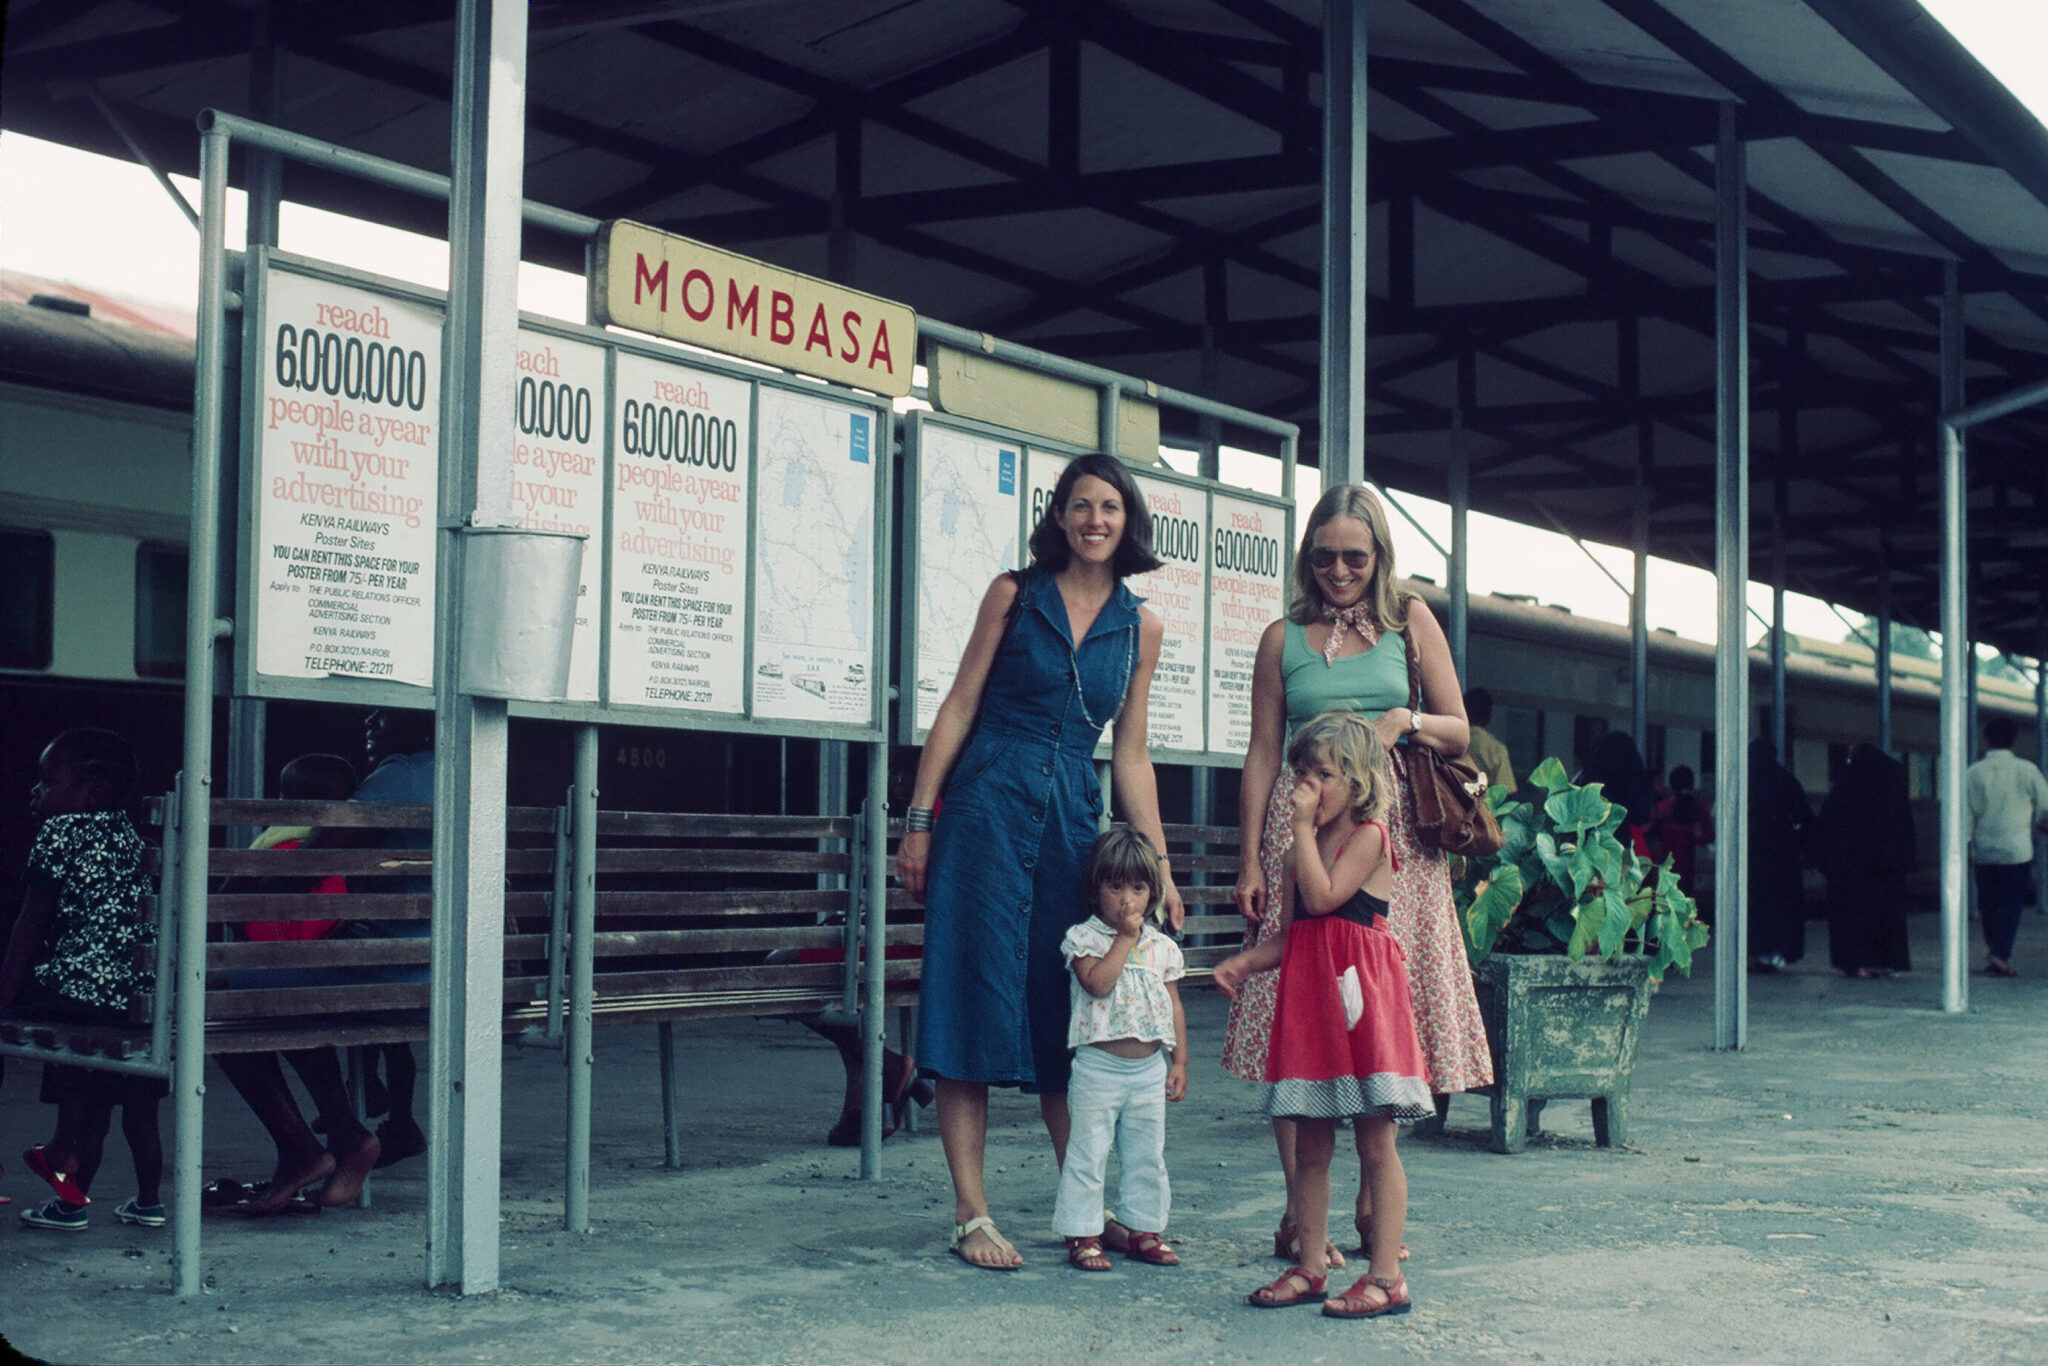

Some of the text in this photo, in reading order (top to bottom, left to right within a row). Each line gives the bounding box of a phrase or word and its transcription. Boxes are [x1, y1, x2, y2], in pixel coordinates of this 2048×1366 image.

[316, 302, 391, 340] reach
[633, 252, 894, 374] MOMBASA
[275, 323, 426, 412] 6,000,000
[653, 379, 710, 411] reach
[268, 397, 431, 447] people a year
[623, 399, 737, 473] 6,000,000
[291, 437, 410, 482] with your
[532, 447, 546, 469] a
[545, 450, 596, 478] year
[525, 482, 578, 512] your
[617, 463, 741, 505] people a year
[272, 472, 423, 529] advertising
[1147, 492, 1182, 515] reach
[300, 512, 390, 536] KENYA RAILWAYS
[633, 496, 726, 535] with your
[1231, 511, 1263, 533] reach
[315, 531, 376, 551] Poster Sites
[621, 527, 736, 575] advertising
[274, 544, 420, 575] YOU CAN RENT THIS SPACE FOR YOUR
[641, 562, 710, 582] KENYA RAILWAYS
[287, 564, 321, 580] POSTER
[321, 568, 347, 584] FROM
[367, 573, 384, 588] PER
[386, 575, 407, 590] YEAR
[652, 578, 699, 596] Poster Sites
[1174, 567, 1201, 589] year
[1212, 574, 1248, 602] people
[1256, 583, 1280, 603] year
[308, 585, 322, 596] THE
[324, 587, 350, 598] PUBLIC
[351, 589, 391, 602] RELATIONS
[308, 598, 359, 612] COMMERCIAL
[621, 591, 733, 615] YOU CAN RENT THIS SPACE FOR YOUR
[1162, 592, 1191, 614] your
[308, 609, 391, 625] ADVERTISING SECTION
[632, 607, 658, 621] POSTER
[658, 611, 677, 624] FROM
[693, 615, 706, 627] PER
[706, 616, 723, 629] YEAR
[1221, 598, 1271, 626] with your
[312, 626, 377, 640] KENYA RAILWAYS
[369, 662, 394, 675] 21211
